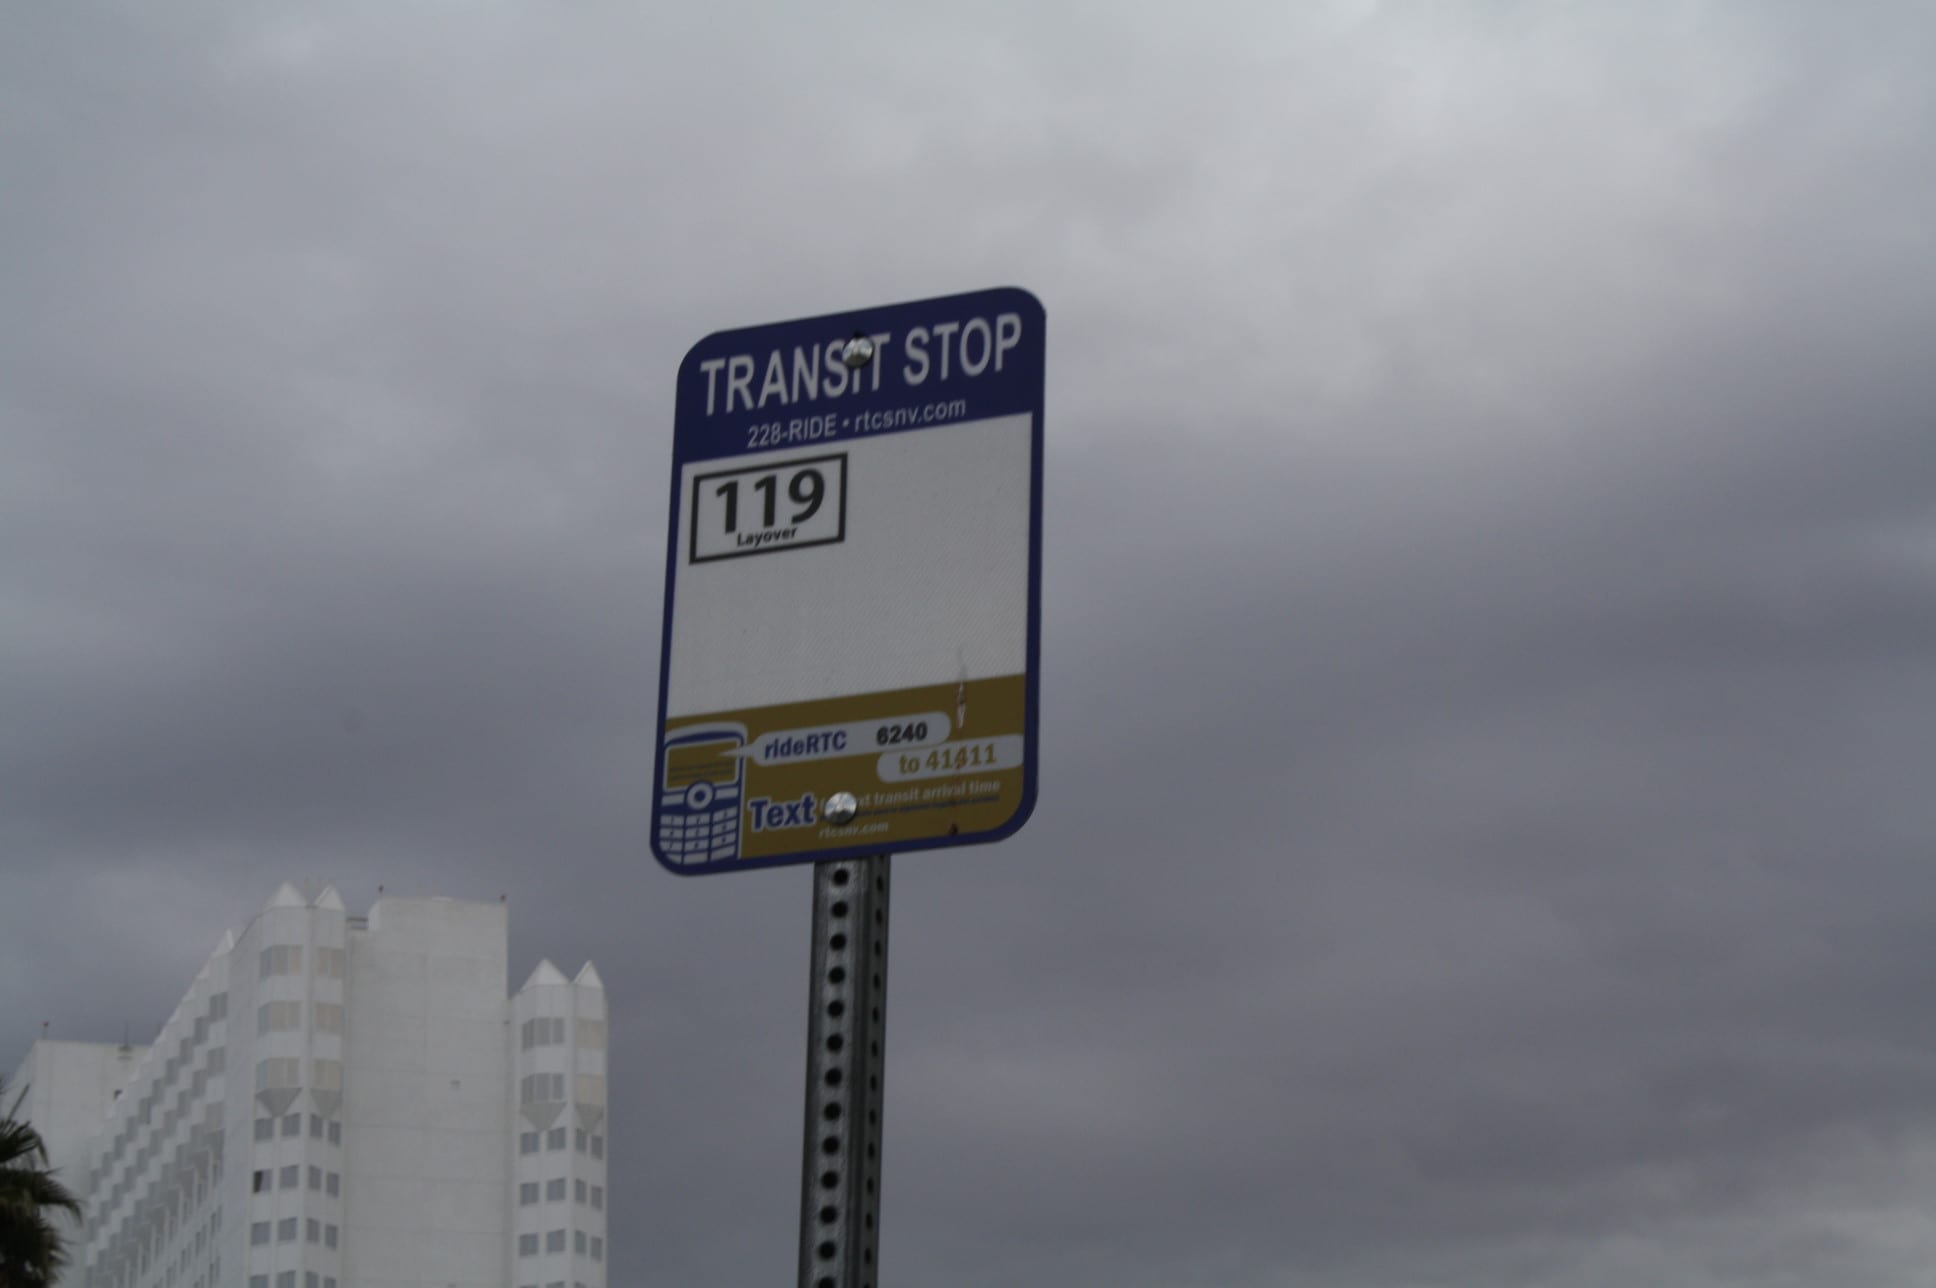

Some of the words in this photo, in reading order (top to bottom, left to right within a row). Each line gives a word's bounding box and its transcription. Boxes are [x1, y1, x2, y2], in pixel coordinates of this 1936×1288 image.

[903, 312, 1022, 387] STOP
[747, 414, 837, 449] 228-RIDE
[854, 398, 966, 433] rtcsnv.com
[715, 467, 825, 535] 119
[737, 526, 798, 549] Layover
[764, 731, 847, 759] rideRTC
[876, 722, 928, 745] 6240
[899, 755, 920, 774] to
[926, 743, 997, 772] 41411
[750, 793, 816, 832] Text
[872, 787, 920, 806] transit
[922, 783, 965, 801] arrival
[967, 780, 1001, 796] time
